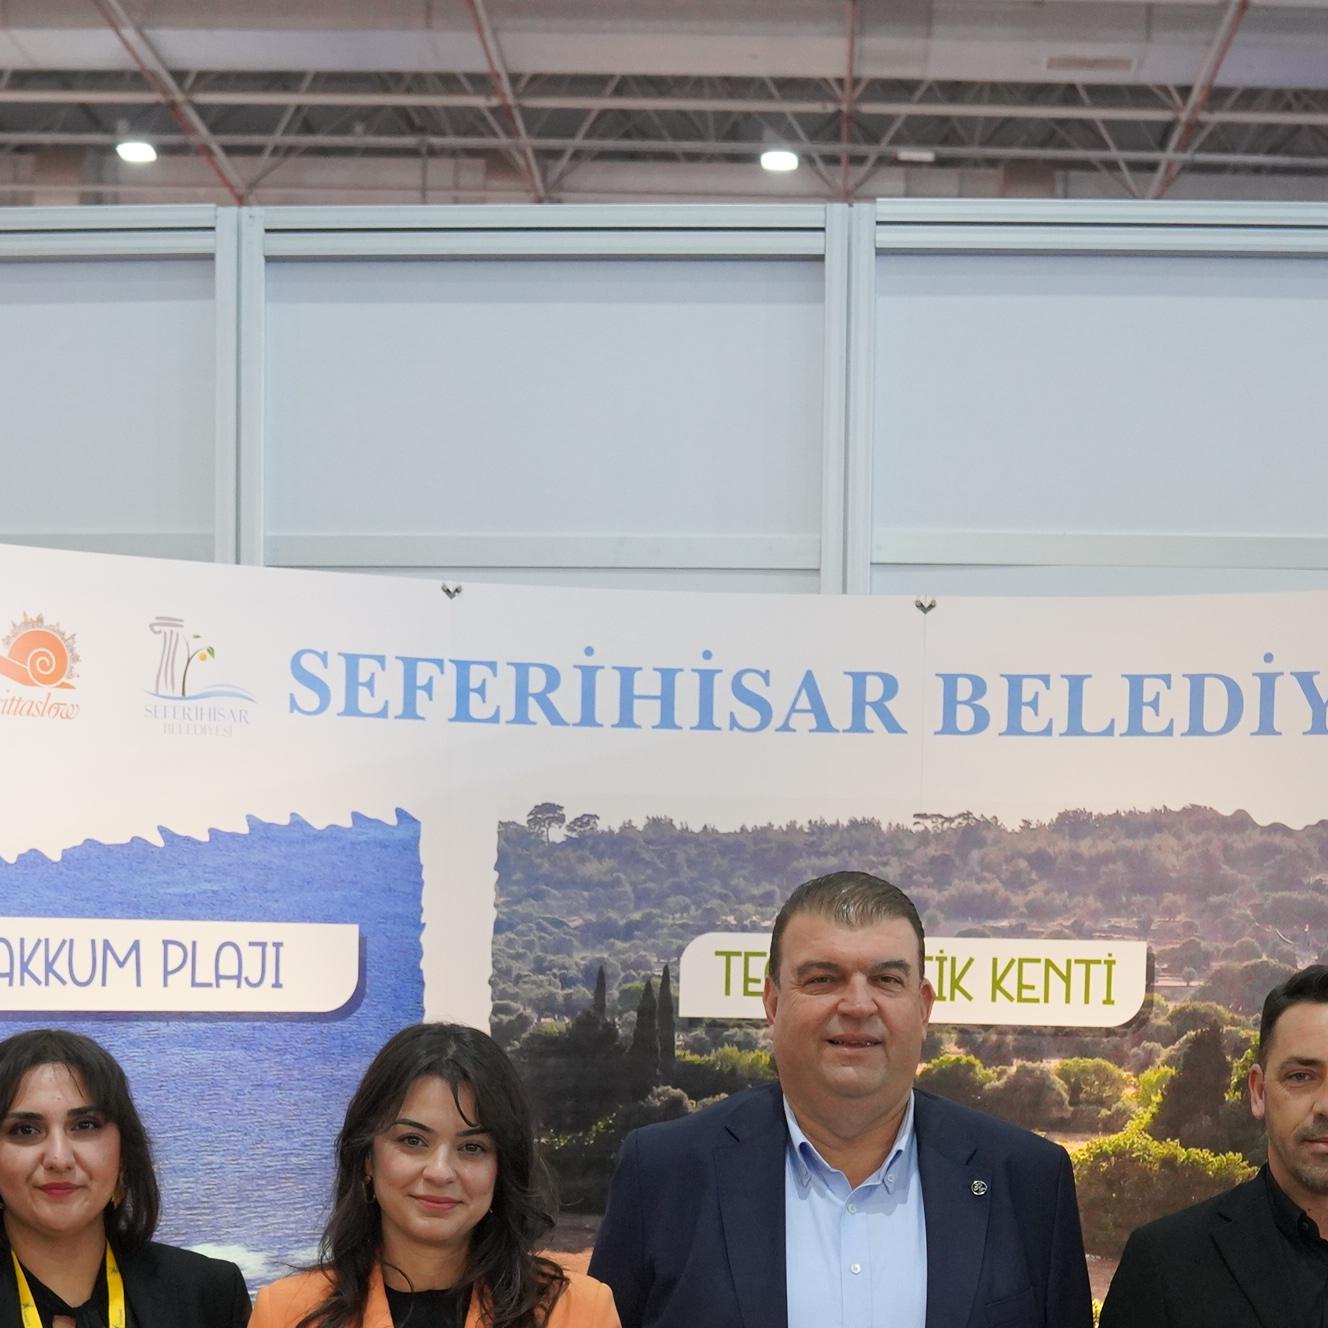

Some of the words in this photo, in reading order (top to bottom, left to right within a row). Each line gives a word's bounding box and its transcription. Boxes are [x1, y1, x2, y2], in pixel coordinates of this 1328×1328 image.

[289, 646, 908, 735] SEFERİHİSAR
[161, 939, 284, 990] PLAJI
[990, 952, 1117, 1006] KENTİ
